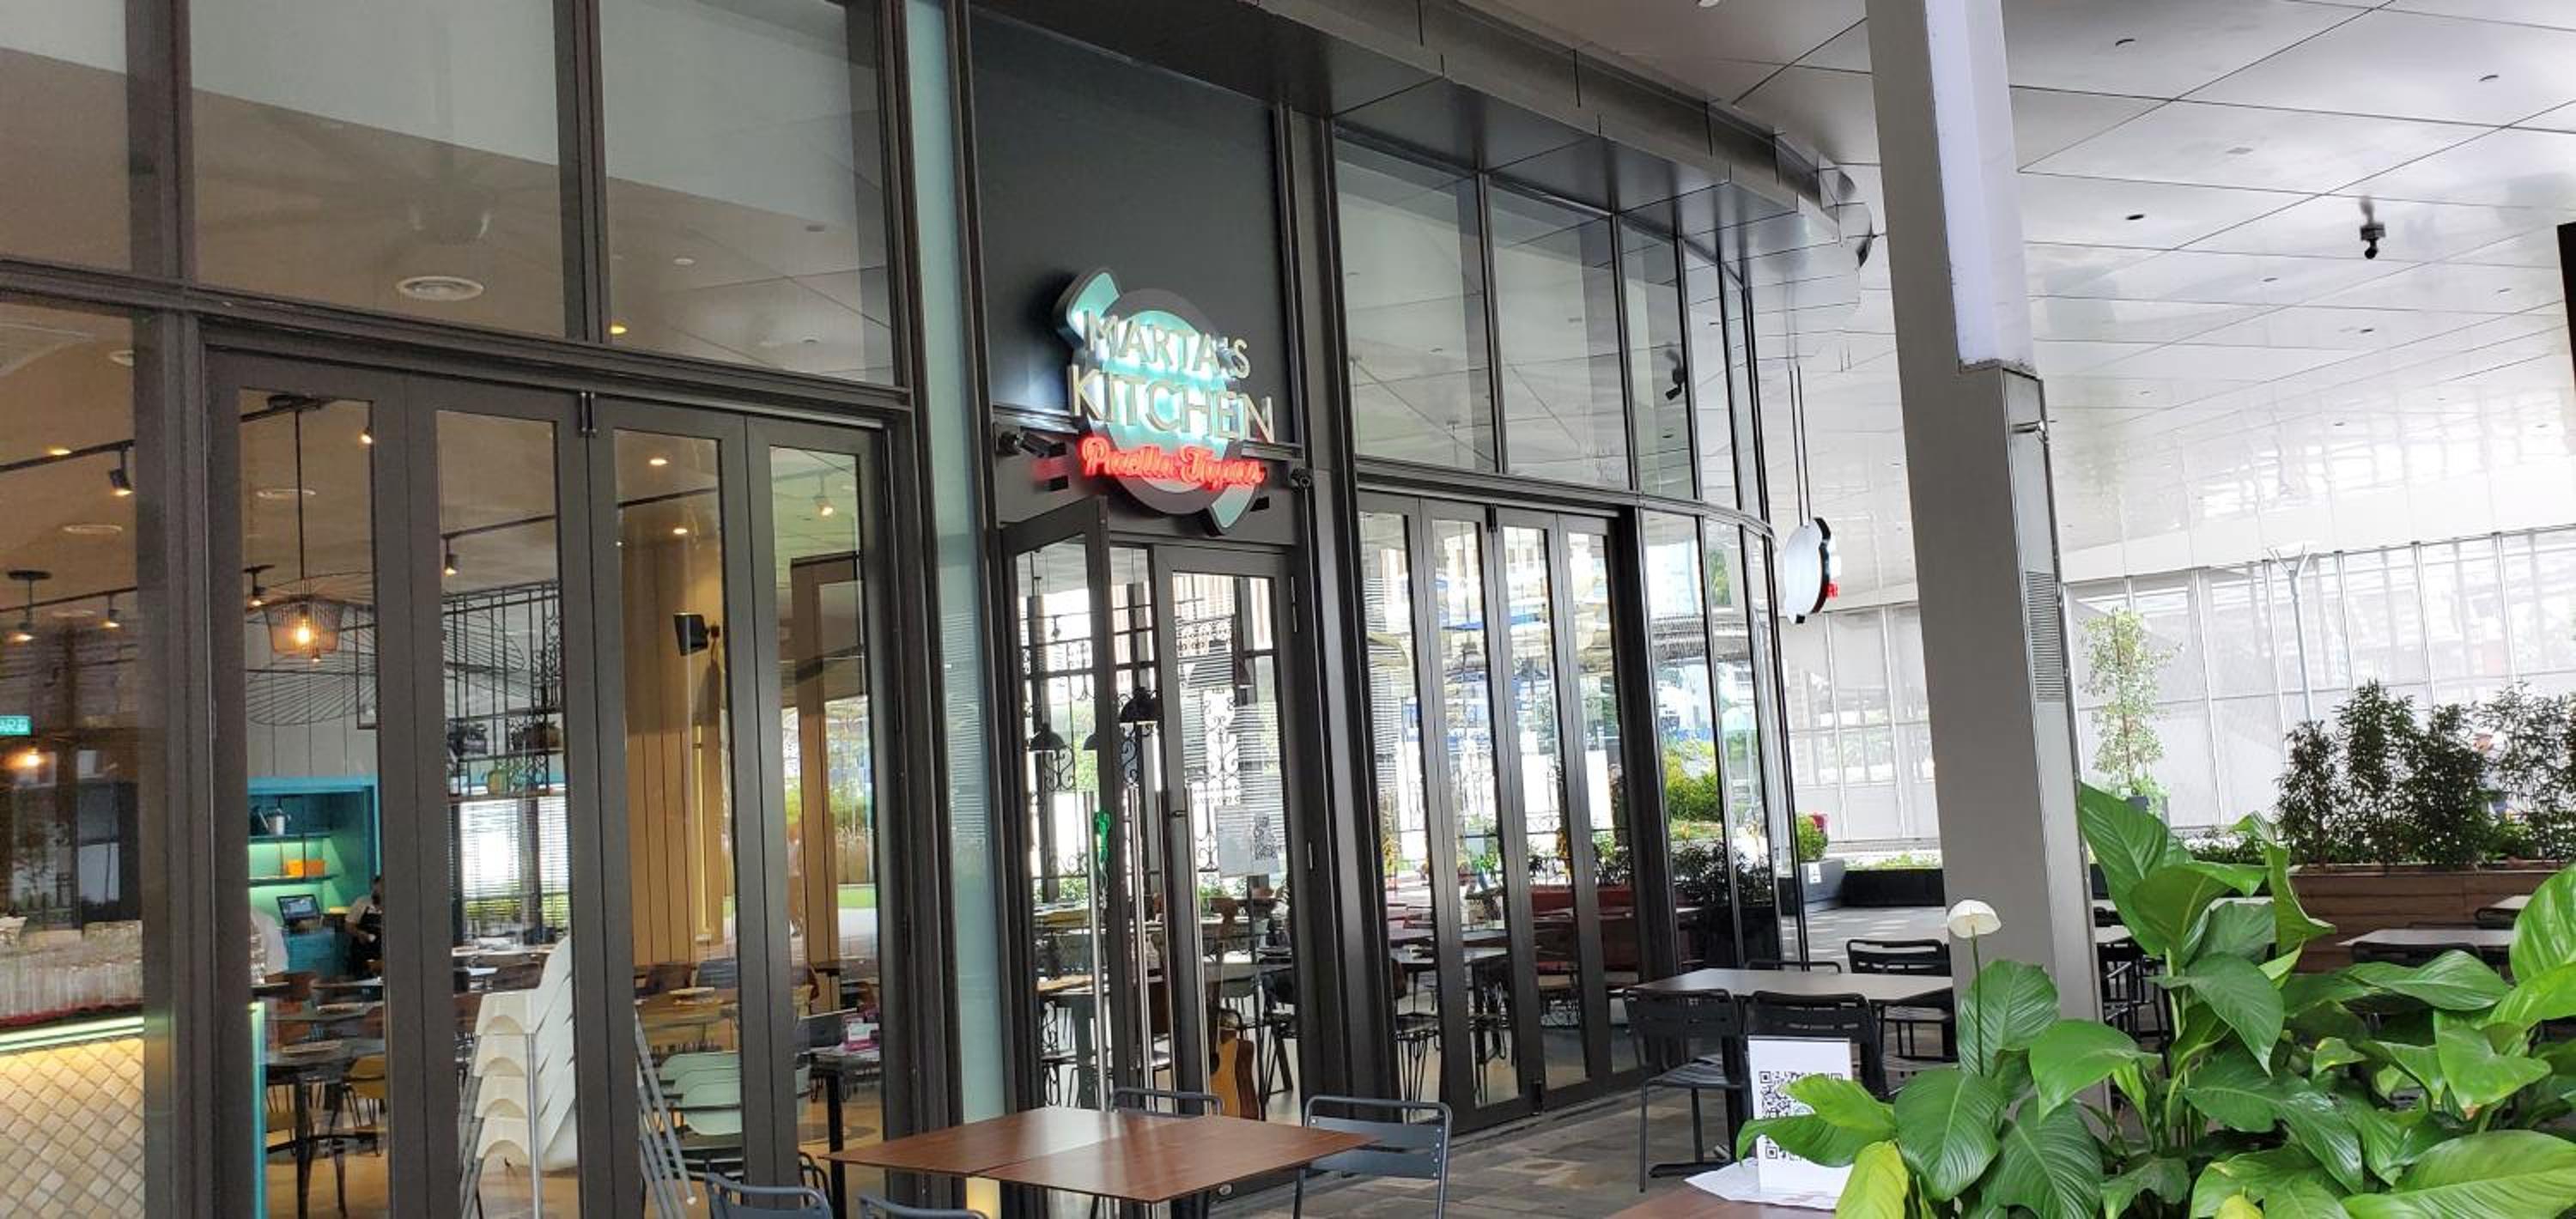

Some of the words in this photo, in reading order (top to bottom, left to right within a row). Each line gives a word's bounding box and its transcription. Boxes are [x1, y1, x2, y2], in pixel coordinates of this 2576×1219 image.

[1083, 310, 1250, 379] MARTA'S
[1067, 363, 1274, 445] KITCHEN
[1080, 436, 1177, 479] Paella
[1180, 444, 1267, 490] Tapas
